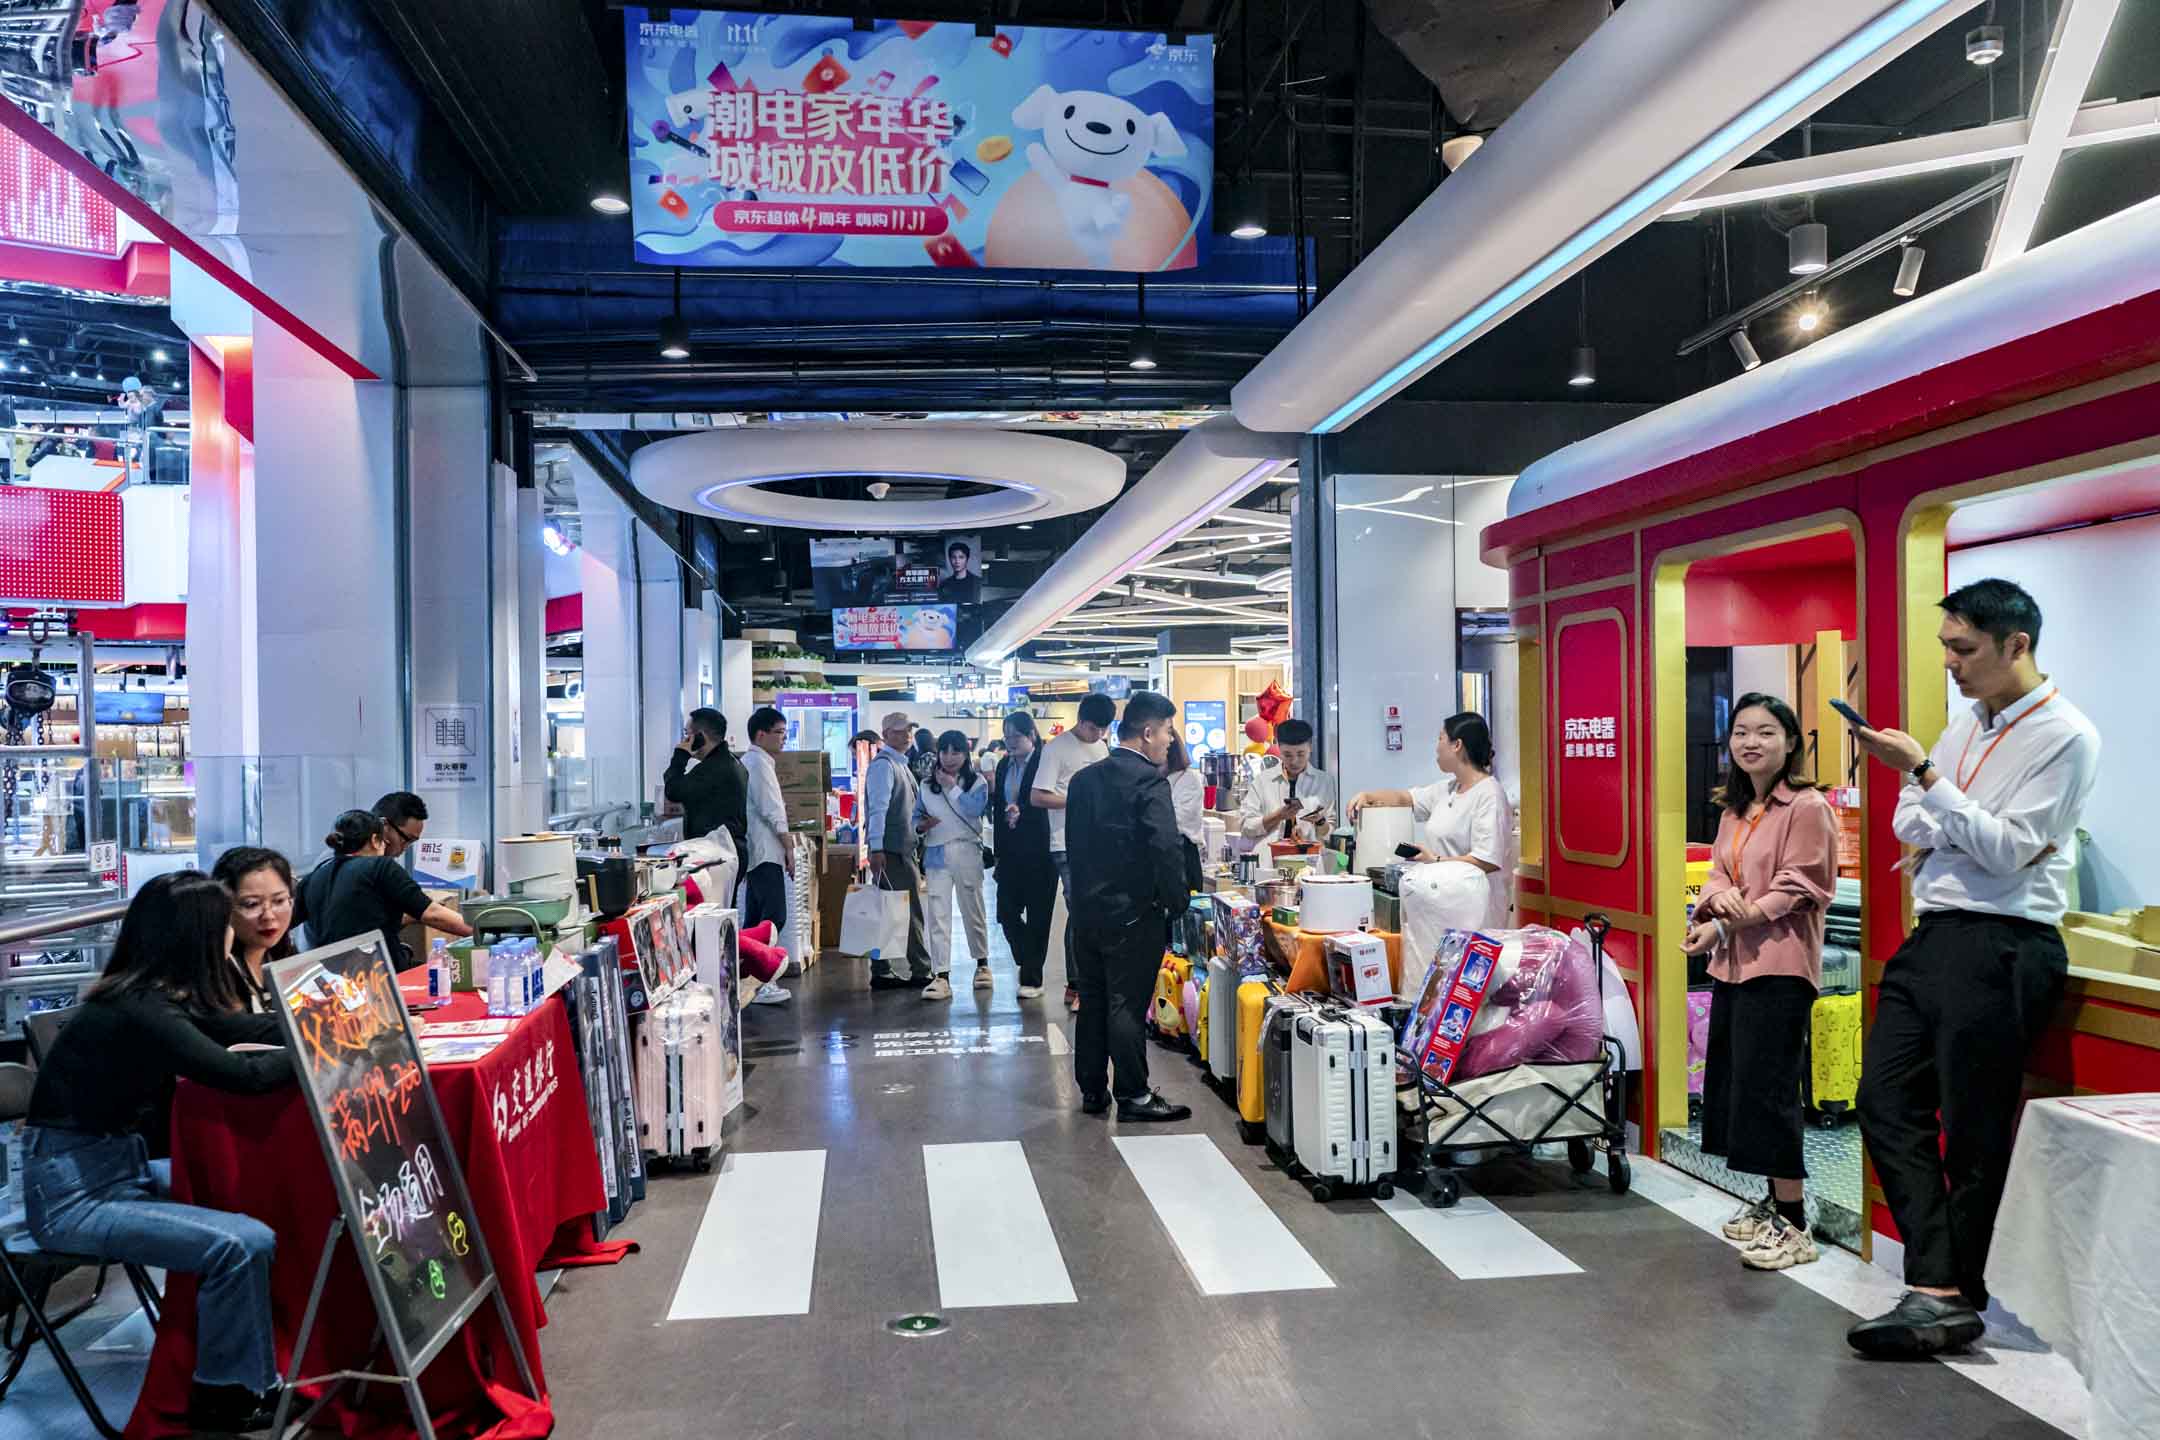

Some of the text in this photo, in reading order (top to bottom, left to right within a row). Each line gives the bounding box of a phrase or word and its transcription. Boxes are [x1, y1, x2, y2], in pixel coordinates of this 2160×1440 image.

[1168, 48, 1199, 63] 京东
[707, 89, 955, 146] 潮电家年华
[706, 139, 951, 194] 城城放低价
[733, 207, 852, 230] 京东超体4周年
[1565, 717, 1616, 740] 京东电器
[450, 956, 461, 983] SAST
[512, 1039, 554, 1116] 交通银行
